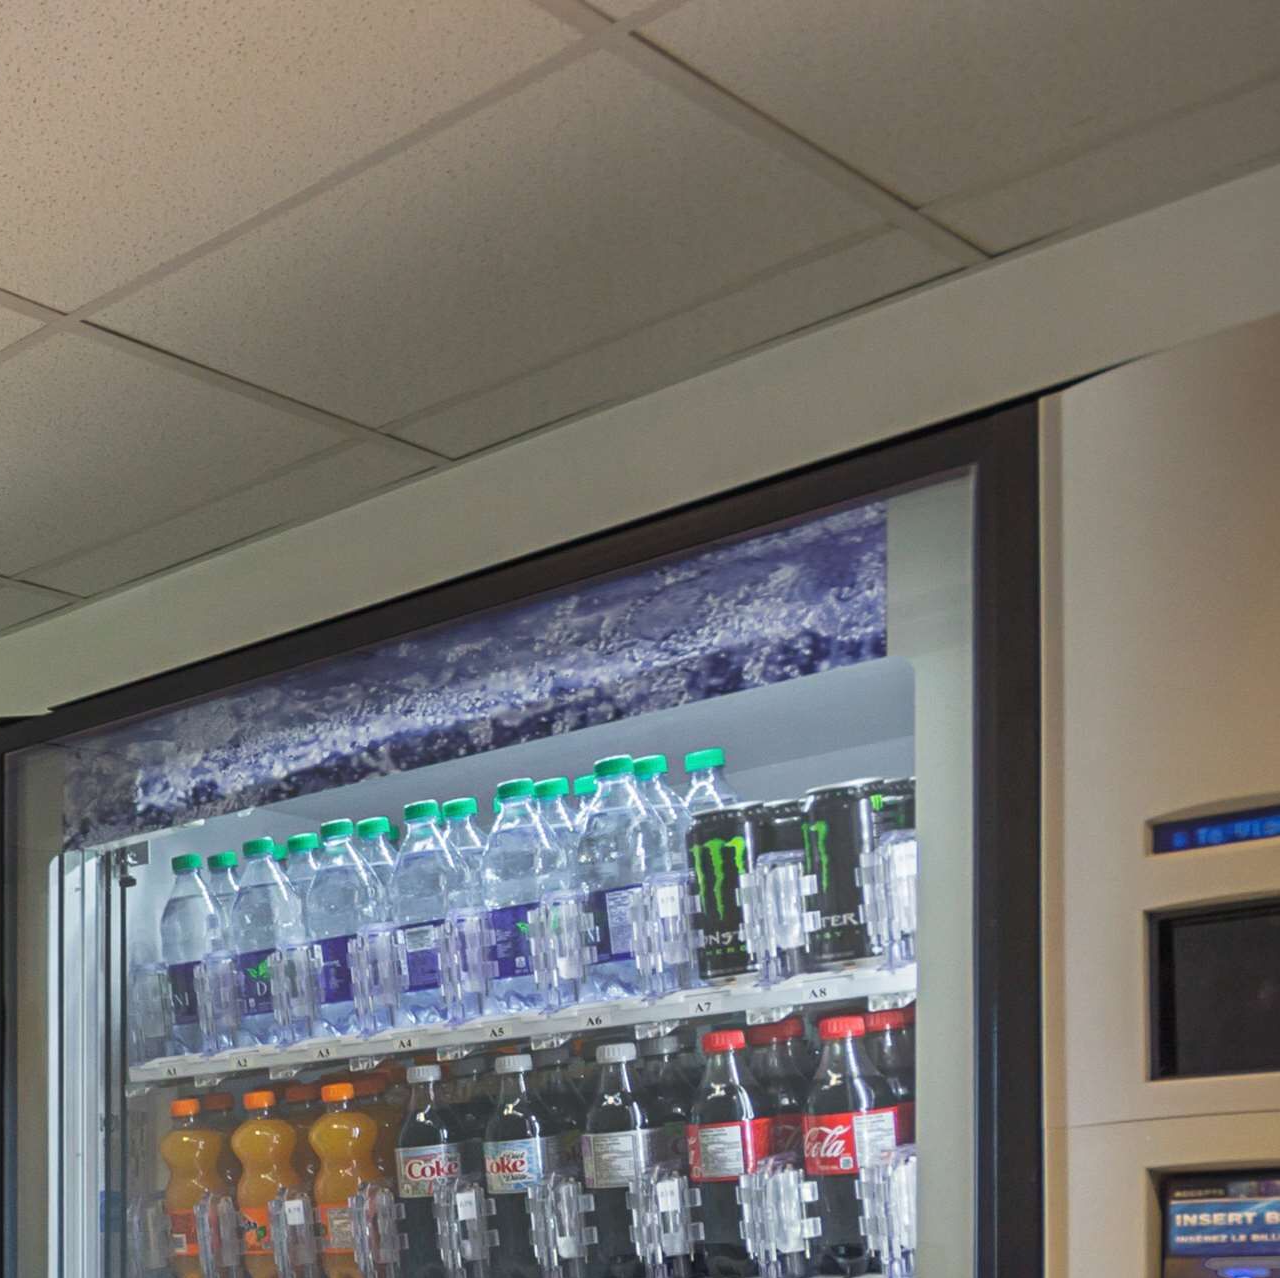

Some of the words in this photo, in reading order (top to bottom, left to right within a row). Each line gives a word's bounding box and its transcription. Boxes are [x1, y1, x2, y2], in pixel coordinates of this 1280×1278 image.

[809, 988, 828, 998] A8
[695, 1002, 712, 1012] A7
[586, 1017, 602, 1027] A6
[490, 1028, 504, 1037] A5
[398, 1039, 412, 1048] A4
[317, 1048, 330, 1058] A3
[236, 1059, 248, 1067] A2
[407, 1157, 459, 1179] Coke
[1175, 1211, 1257, 1227] INSERT
